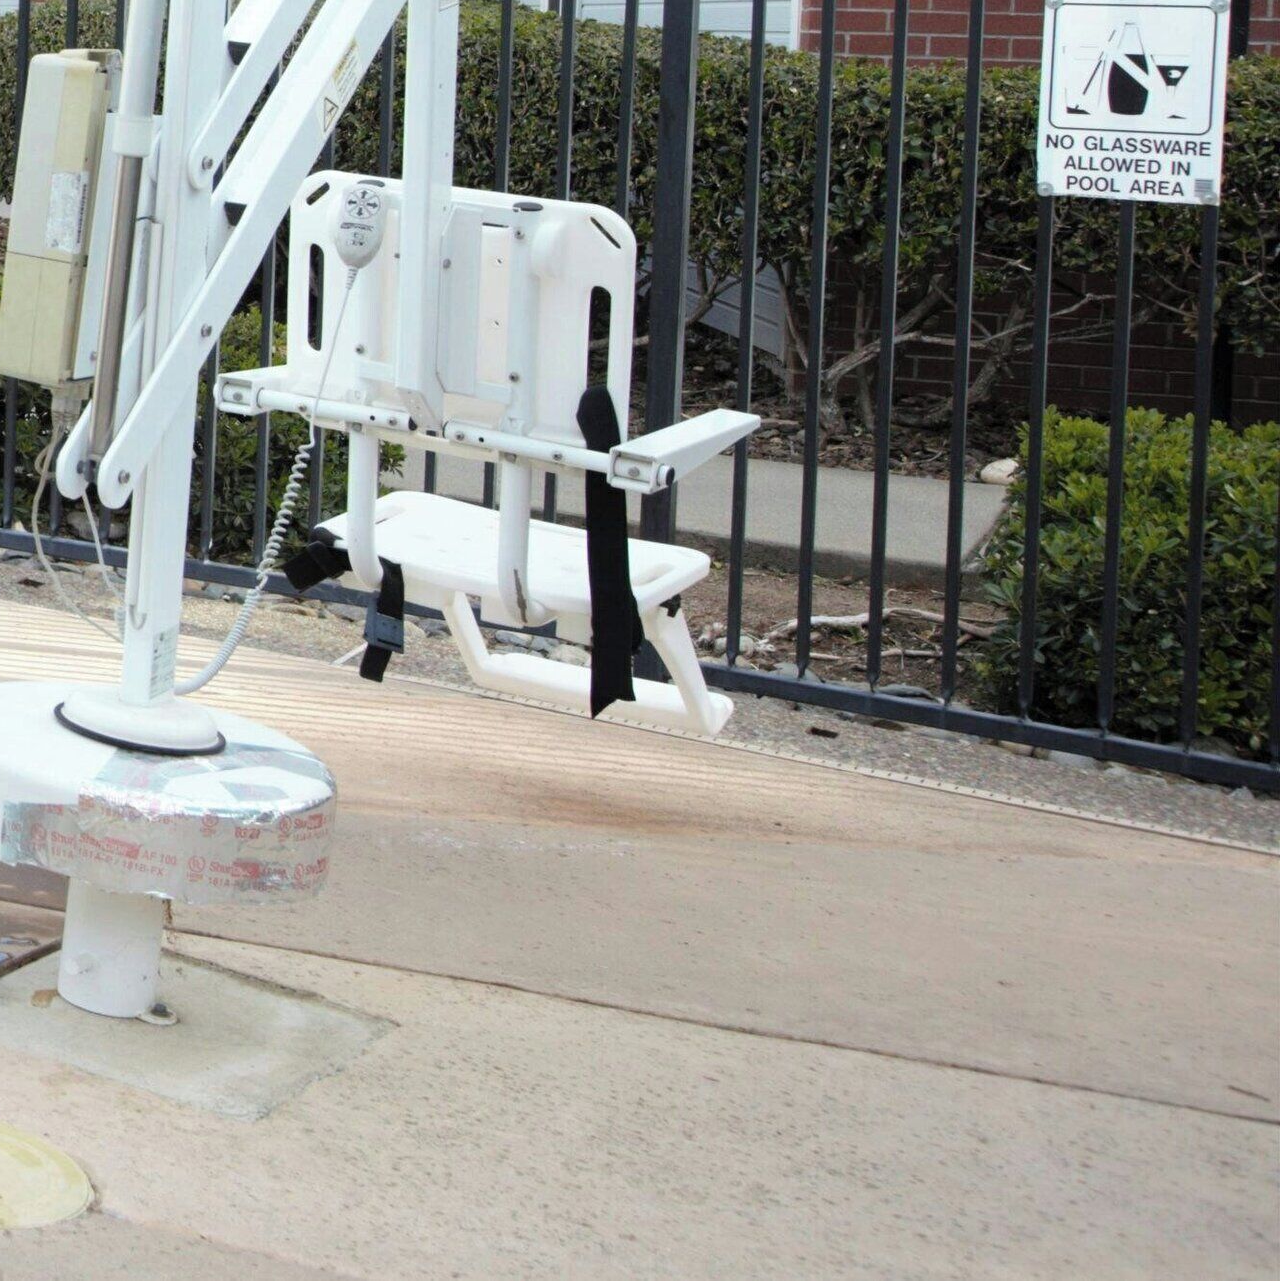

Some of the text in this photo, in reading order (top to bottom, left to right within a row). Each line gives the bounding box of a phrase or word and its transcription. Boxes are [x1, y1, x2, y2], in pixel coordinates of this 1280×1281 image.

[1045, 133, 1212, 157] NO GLASSWARE
[1064, 155, 1192, 177] ALLOWED IN
[1066, 175, 1121, 193] POOL
[1129, 179, 1185, 197] AREA
